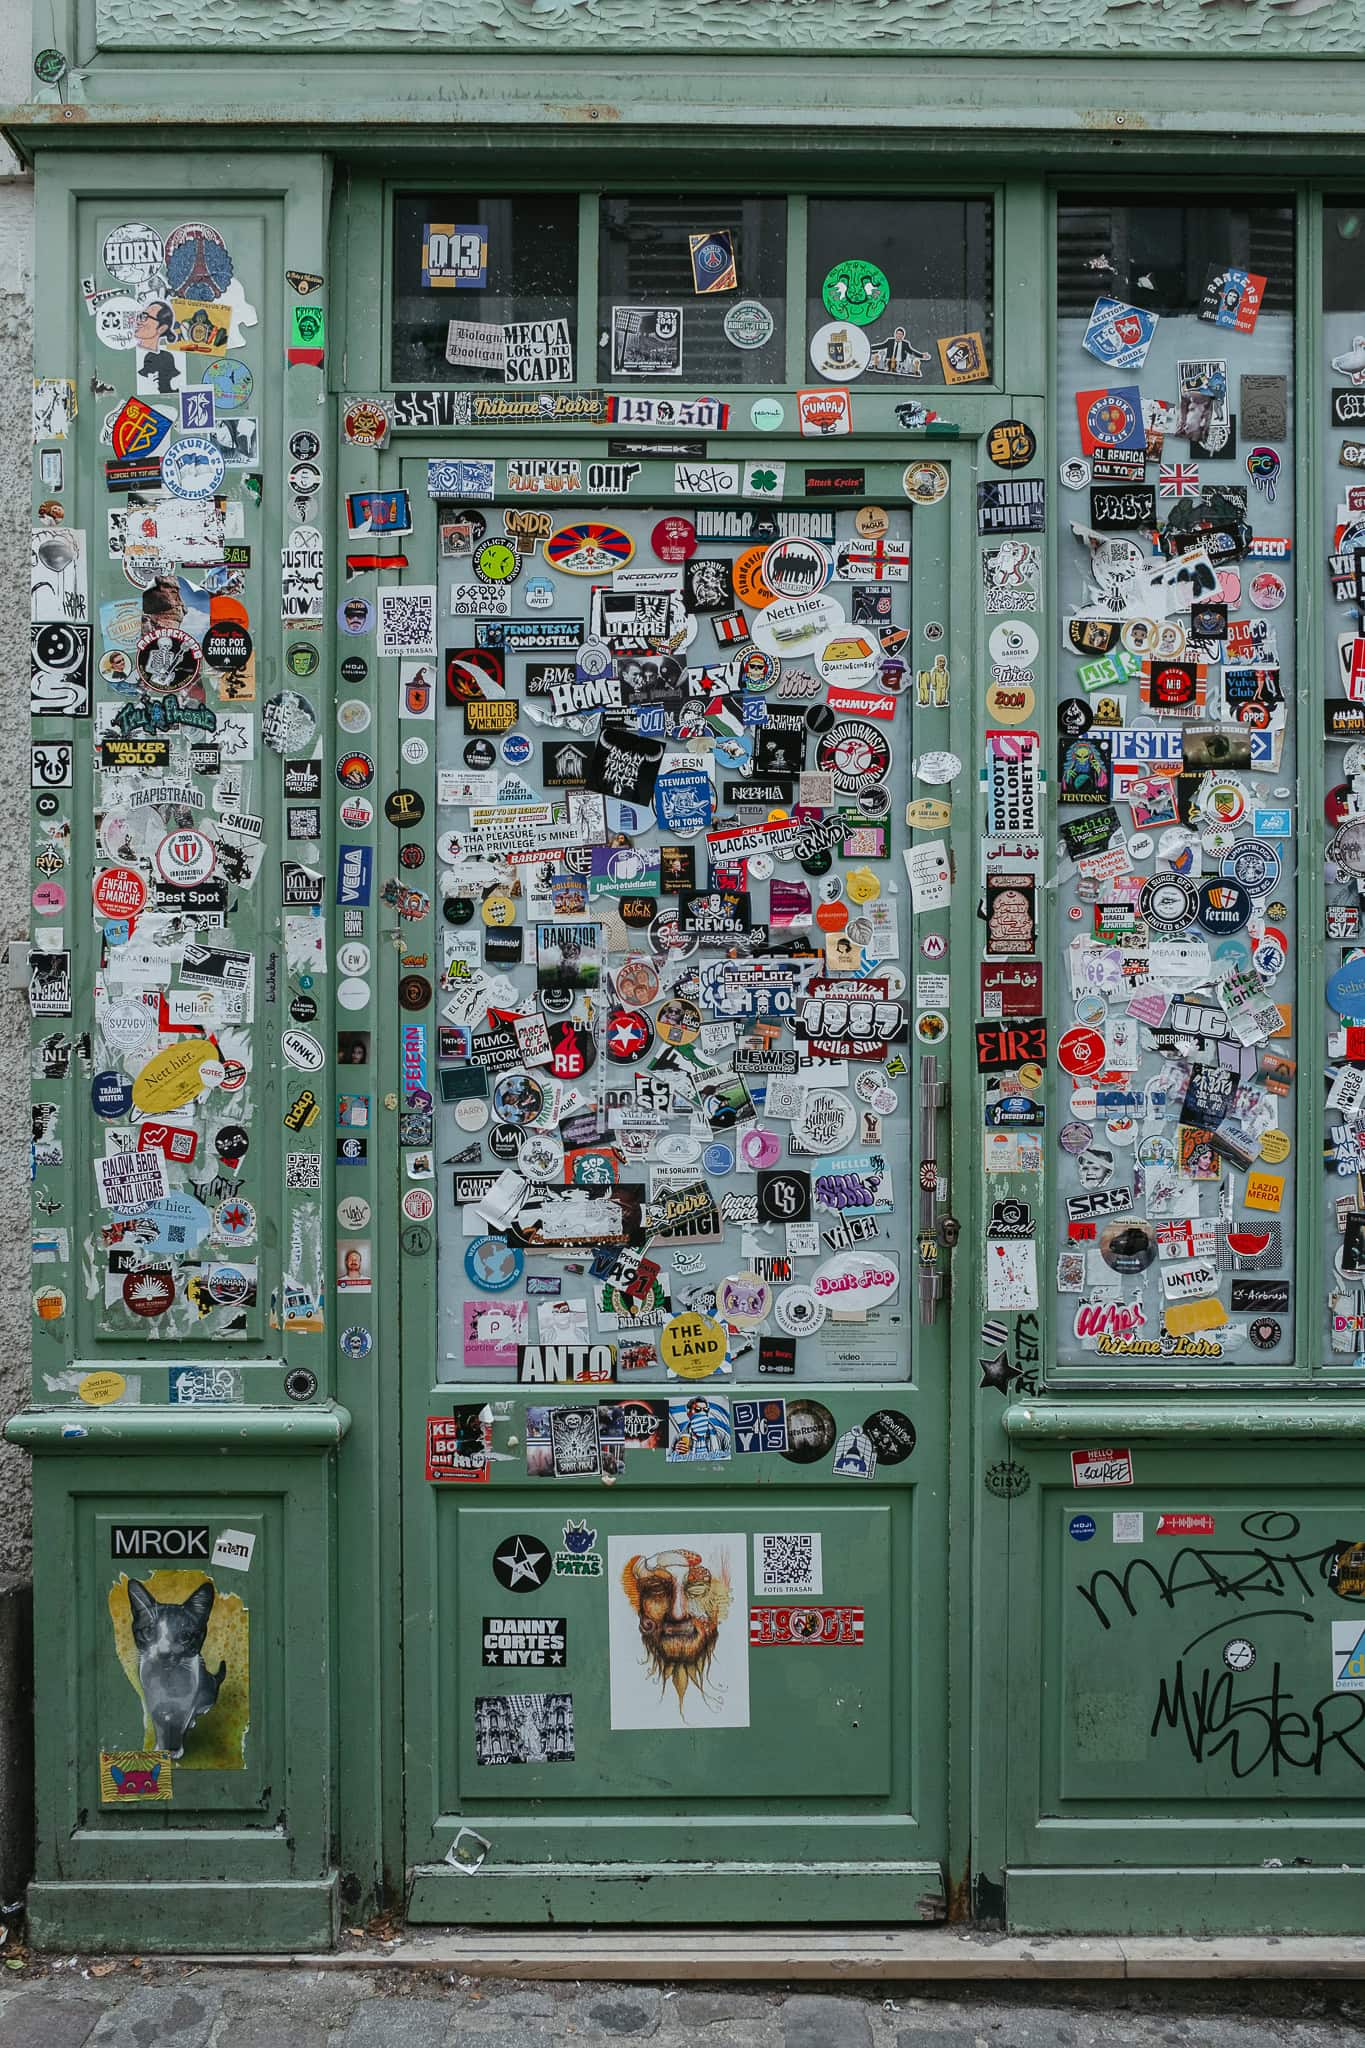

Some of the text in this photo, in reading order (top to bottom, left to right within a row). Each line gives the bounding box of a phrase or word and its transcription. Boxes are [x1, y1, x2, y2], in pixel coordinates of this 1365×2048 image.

[106, 242, 163, 265] HORN
[429, 233, 481, 269] 013
[504, 321, 568, 345] MECCA
[506, 358, 571, 383] SCAPE
[474, 396, 602, 415] Tribune Loire
[623, 398, 653, 422] 19
[1091, 397, 1130, 415] HAJDUK
[678, 403, 714, 426] 50
[994, 424, 1024, 437] anni
[1098, 431, 1128, 443] SPLIT
[165, 440, 217, 466] OSTKURVE
[508, 460, 580, 479] STICKER
[169, 468, 223, 498] HERTHA BSC
[862, 522, 884, 530] PAGUS
[851, 542, 904, 553] Nord Sud
[282, 551, 323, 568] JUSTICE
[617, 572, 678, 581] INCOGNITO
[850, 565, 901, 576] Ovest Est
[282, 597, 313, 615] NOW
[766, 600, 825, 622] Nett hier.
[503, 625, 580, 634] FENDE TESTAS
[210, 639, 245, 647] FOR POT
[505, 636, 579, 646] COMPOSTELA
[208, 647, 247, 656] SMOKING
[1226, 678, 1256, 687] Vulva
[994, 691, 1025, 708] ZOOM
[1229, 688, 1254, 697] Club
[467, 704, 511, 717] CHICOS
[1243, 711, 1264, 722] OPPS
[106, 743, 166, 752] WALKER
[114, 754, 155, 764] SOLO
[682, 756, 703, 767] ESN
[504, 780, 520, 789] jbg
[658, 775, 707, 788] STEWARTON
[1021, 743, 1033, 830] HACHETTE
[129, 788, 203, 808] TRAPISTRANO
[994, 754, 1006, 830] BOYCOTT
[668, 818, 704, 827] ON TOUR
[538, 830, 578, 842] IS MINE!
[742, 826, 765, 835] CHILE
[464, 835, 484, 845] THA
[464, 841, 535, 853] THA PRIVILEGE
[710, 836, 757, 856] PLACAS
[793, 824, 855, 860] GRANDA
[35, 857, 64, 868] RVC
[511, 851, 562, 864] BARFDOG
[117, 871, 128, 879] LES
[342, 849, 362, 903] VEGA
[102, 878, 139, 893] ENFANTS
[1151, 875, 1176, 890] SURGE
[105, 890, 140, 906] MARCHÉ
[157, 891, 219, 904] Best Spot
[623, 904, 651, 914] RICK
[1205, 909, 1239, 922] ferma
[344, 921, 362, 932] BOWL
[684, 918, 743, 932] CREW96
[1146, 916, 1174, 930] UNITED
[1329, 923, 1359, 938] SVZ
[543, 927, 596, 950] BANDZIOR
[348, 956, 360, 964] EW
[725, 971, 793, 982] STEHPLATZ
[143, 993, 158, 1006] SOS
[110, 1020, 146, 1028] SYZYGY
[802, 1003, 902, 1037] 1987
[286, 1036, 316, 1064] LRNKL
[172, 1052, 195, 1070] hier.
[406, 1027, 421, 1091] FEIERN
[555, 1054, 580, 1072] RE
[736, 1051, 796, 1065] LEWIS
[100, 1086, 122, 1094] TRÄUM
[1336, 1071, 1356, 1105] nina's
[1343, 1075, 1363, 1111] house
[99, 1094, 123, 1102] WEITER!
[813, 1096, 833, 1110] The
[103, 1158, 135, 1178] FIALOVA
[832, 1160, 870, 1170] HELLO
[123, 1173, 154, 1183] JAHRE
[106, 1181, 164, 1205] GONZO ULTRAS
[1252, 1182, 1280, 1192] LAZIO
[1248, 1190, 1280, 1202] MERDA
[117, 1205, 149, 1215] RACISM
[816, 1269, 895, 1295] Don't Flop
[669, 1325, 702, 1339] THE
[672, 1341, 718, 1357] LÄND
[1174, 1337, 1221, 1357] Loire
[521, 1346, 611, 1382] ANTO
[838, 1353, 860, 1361] video
[1087, 1449, 1113, 1459] HELLO
[991, 1476, 1022, 1489] CISV
[115, 1530, 208, 1556] MROK
[556, 1562, 601, 1575] PATAS
[490, 1619, 560, 1635] DANNY
[484, 1634, 565, 1650] CORTES
[503, 1650, 545, 1666] NYC
